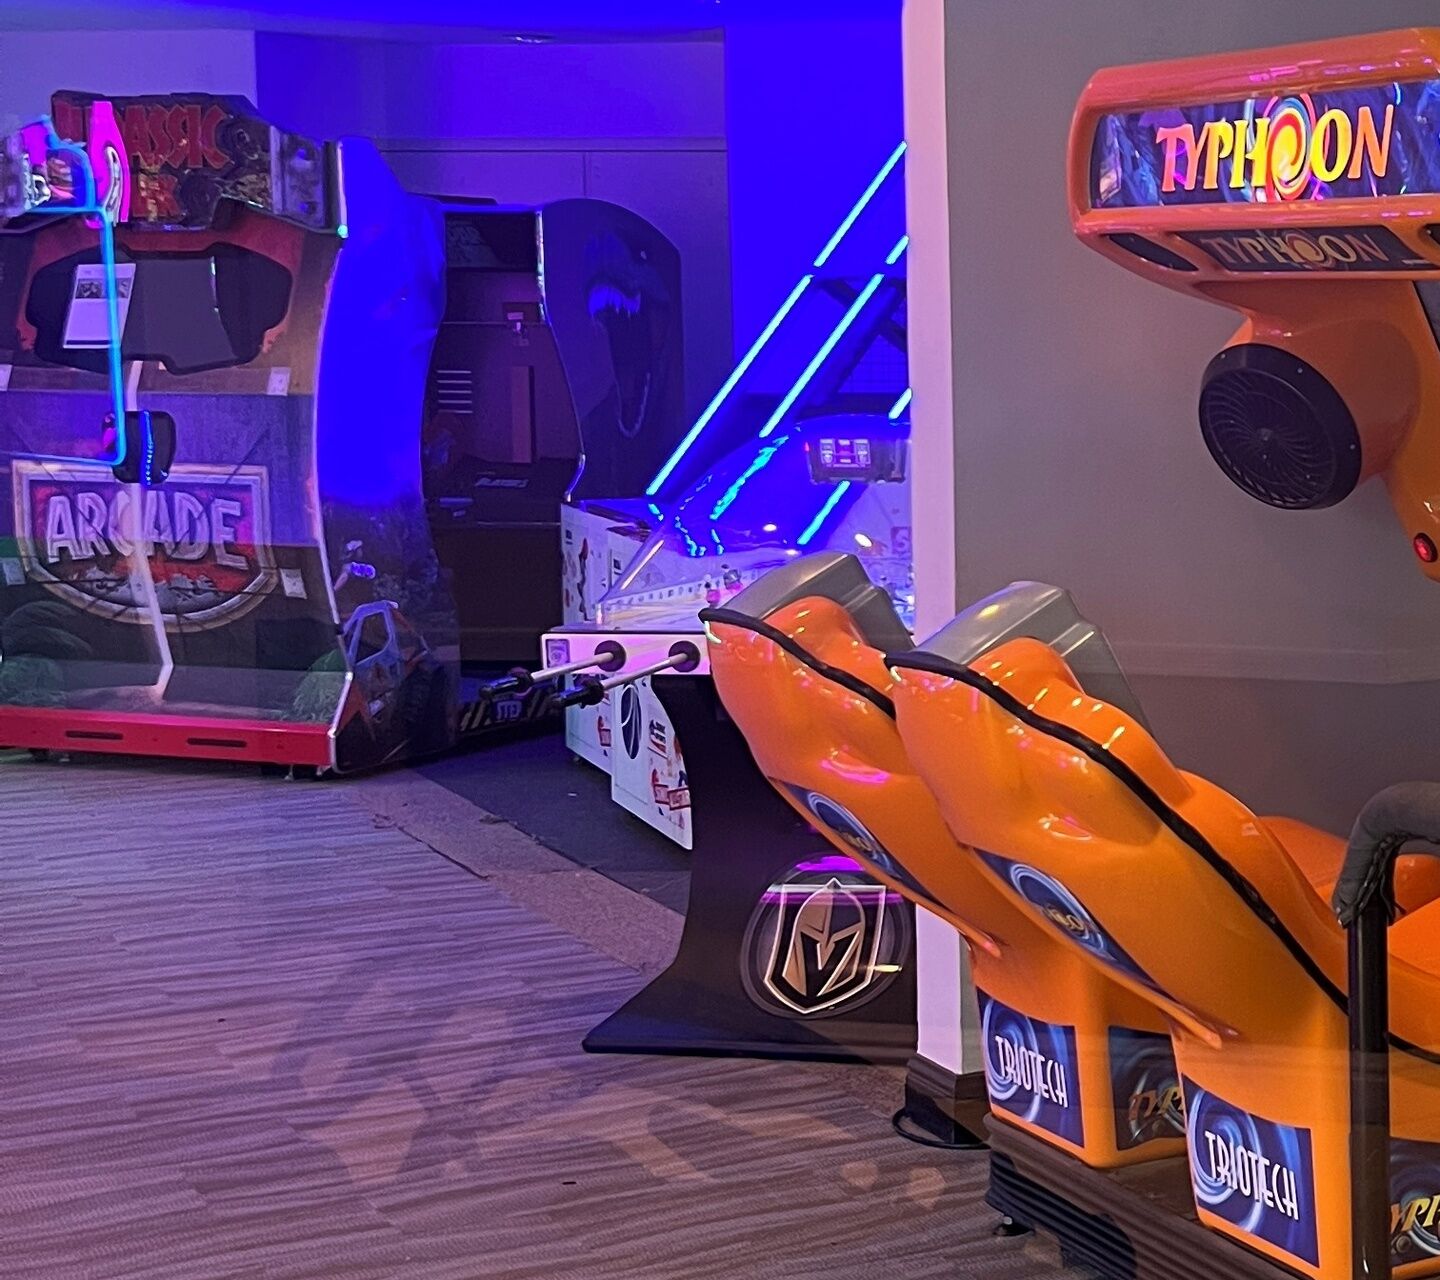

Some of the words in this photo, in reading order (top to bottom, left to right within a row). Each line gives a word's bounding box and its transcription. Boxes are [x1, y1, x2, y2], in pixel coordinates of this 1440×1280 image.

[1156, 100, 1394, 199] TYPHOON
[1201, 229, 1390, 269] TYPHOON
[46, 490, 250, 570] ARCADE
[995, 1035, 1069, 1108] TRIOTECH
[1204, 1130, 1299, 1221] TRIOTECH
